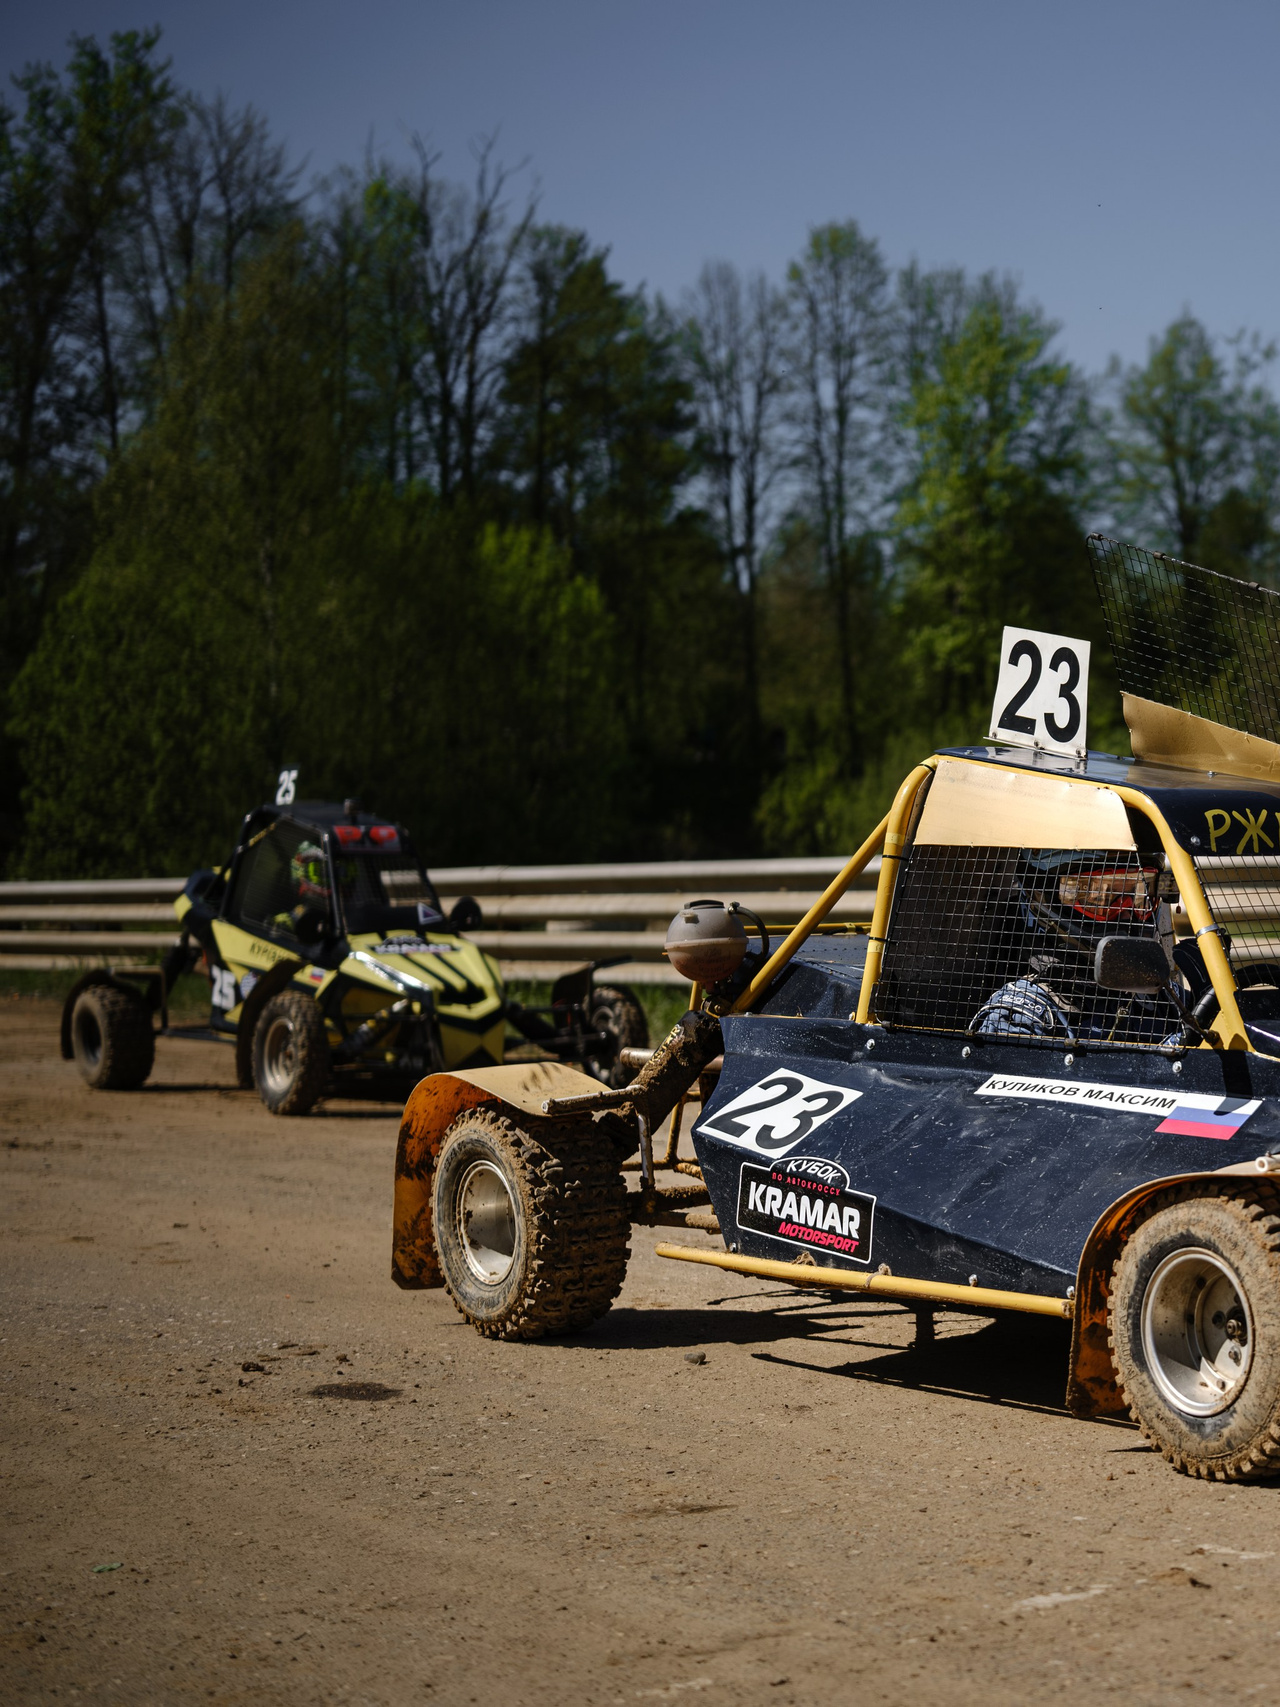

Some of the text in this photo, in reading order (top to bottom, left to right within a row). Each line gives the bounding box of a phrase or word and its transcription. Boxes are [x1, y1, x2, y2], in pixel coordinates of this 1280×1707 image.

[998, 639, 1081, 743] 23
[276, 770, 298, 806] 25
[211, 964, 236, 1011] 25
[985, 1080, 1177, 1109] КУЛИКОВ МАКСИМ
[704, 1076, 844, 1150] 23
[772, 1172, 841, 1196] ПО АВТОКРОССУ
[786, 1160, 841, 1184] КУБОК
[748, 1181, 861, 1239] KRAMAR
[778, 1222, 860, 1253] MOTORSPORT
